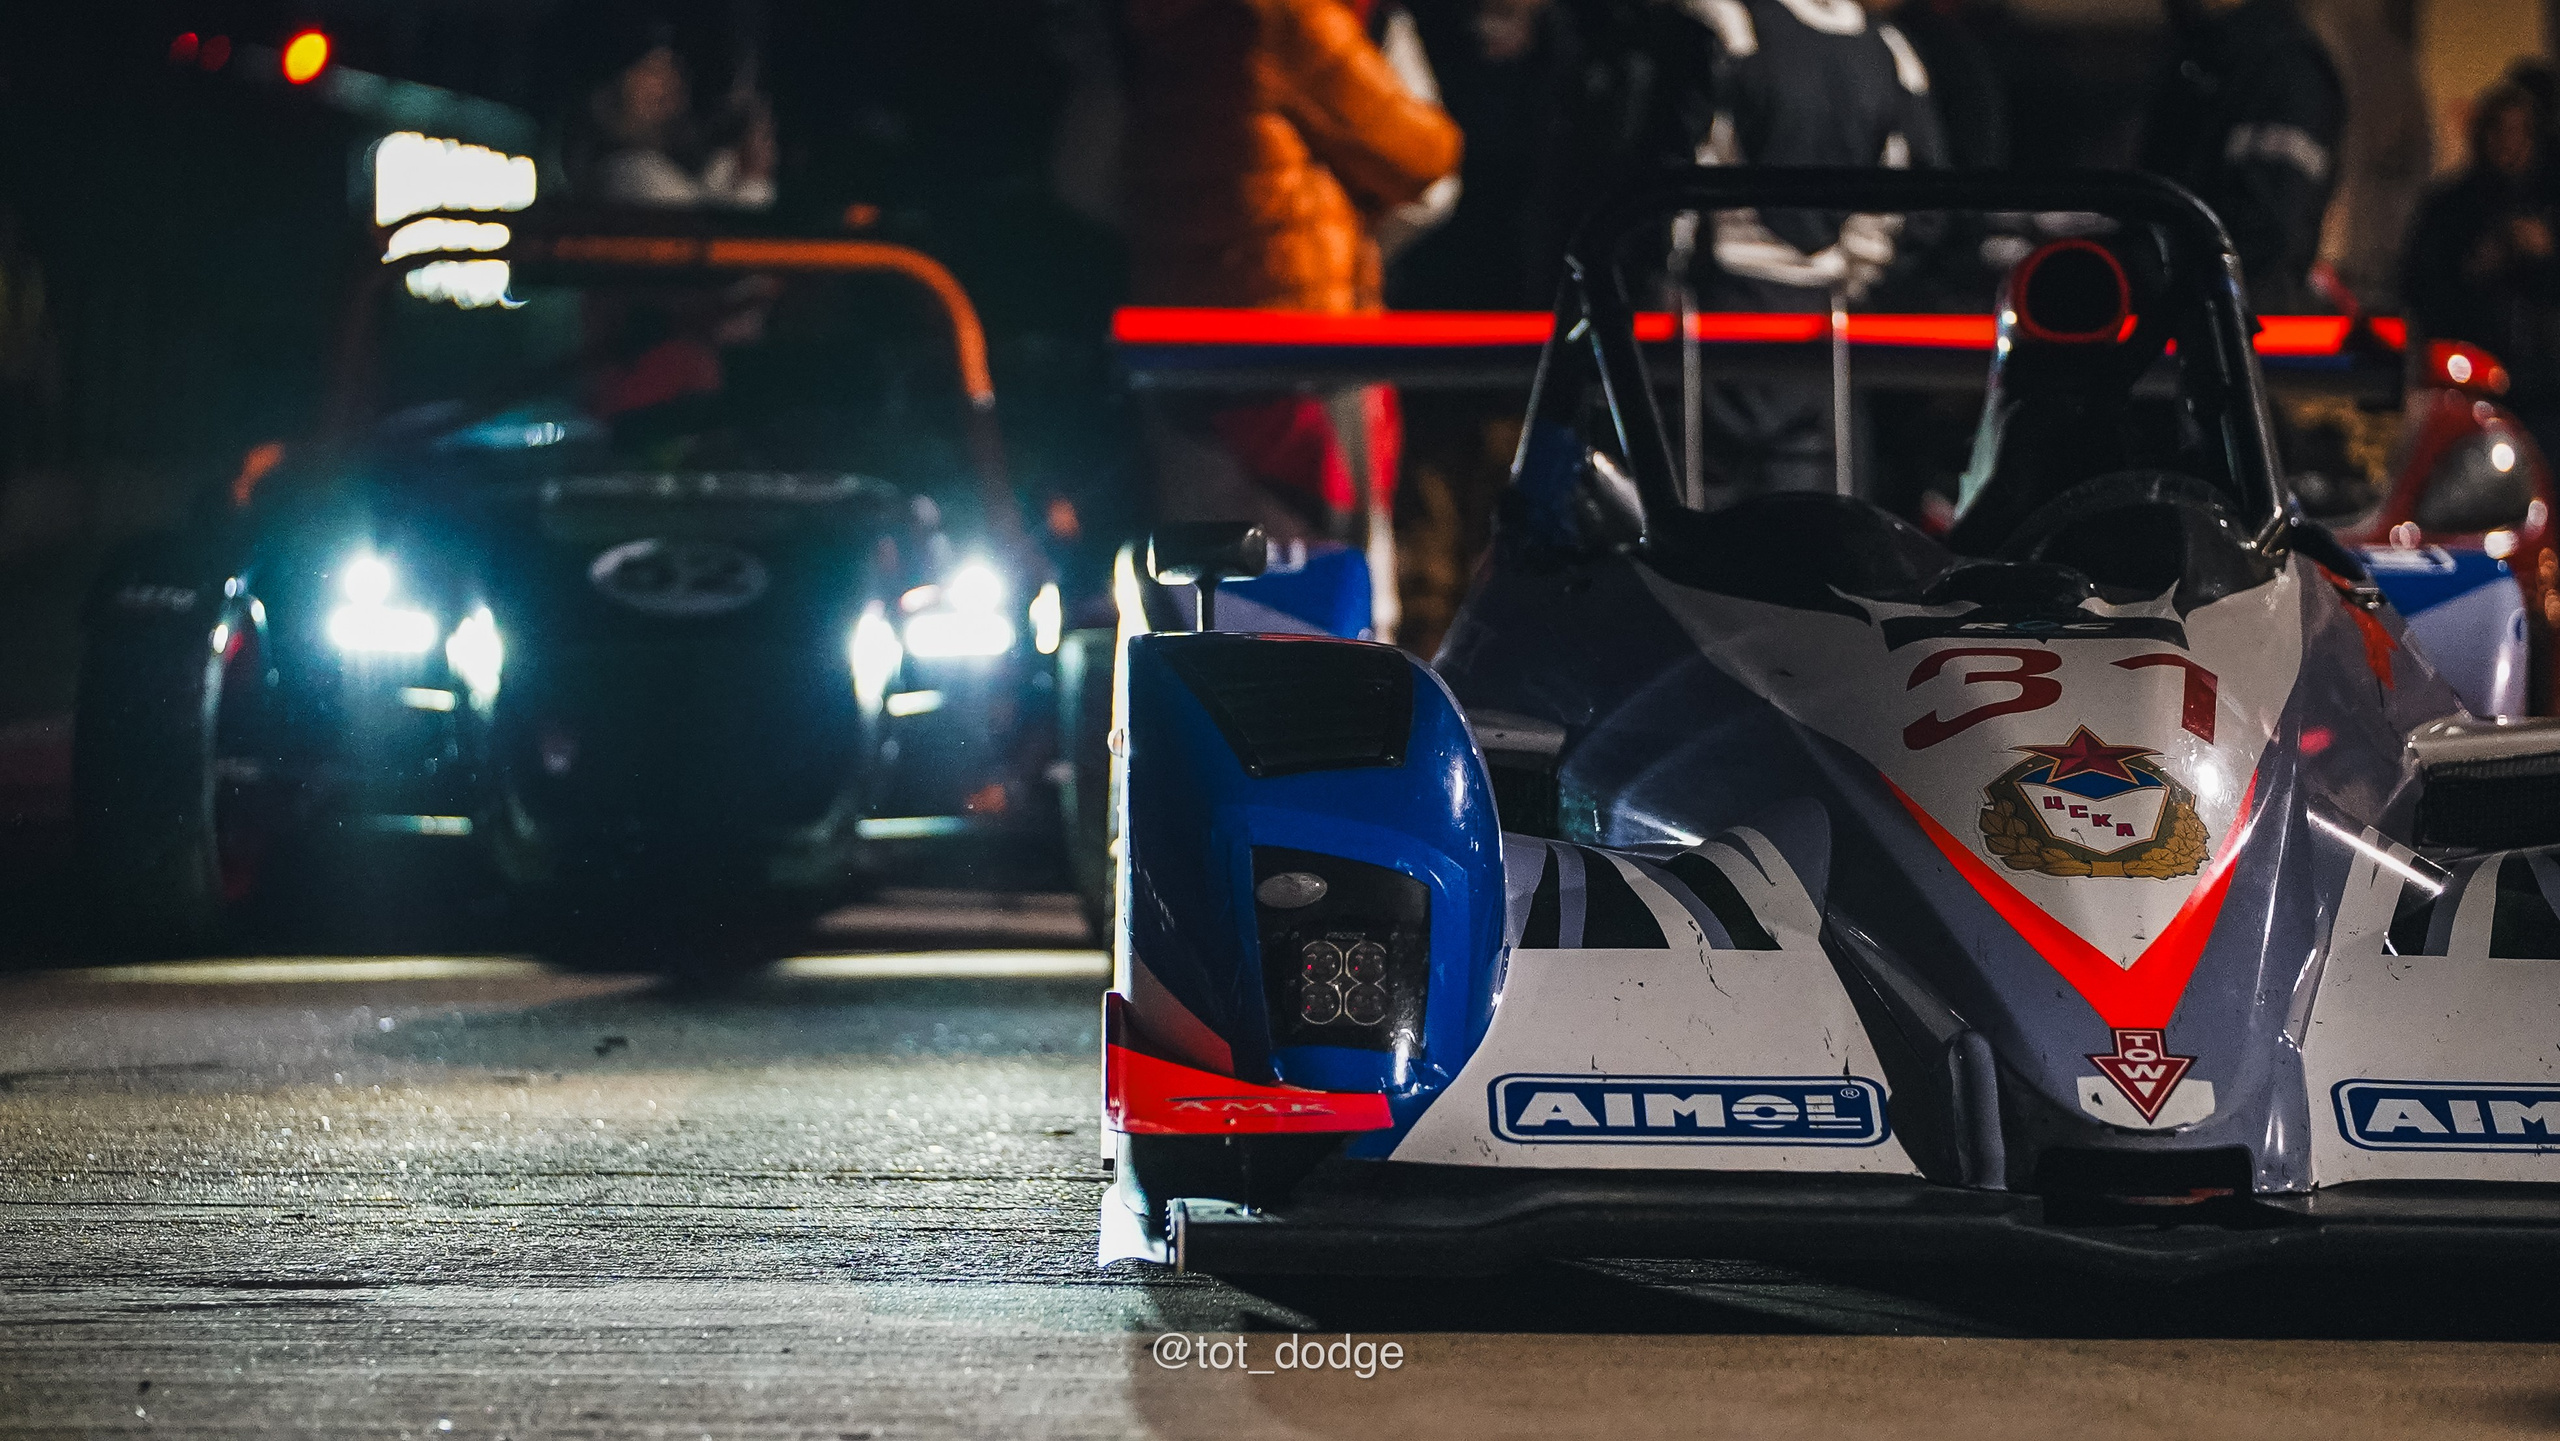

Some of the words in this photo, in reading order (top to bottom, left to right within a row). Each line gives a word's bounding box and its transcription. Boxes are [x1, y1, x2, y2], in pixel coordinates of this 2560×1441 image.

[1902, 647, 2219, 751] 31
[2042, 795, 2136, 837] ЦСКА
[2117, 1035, 2168, 1080] TOW
